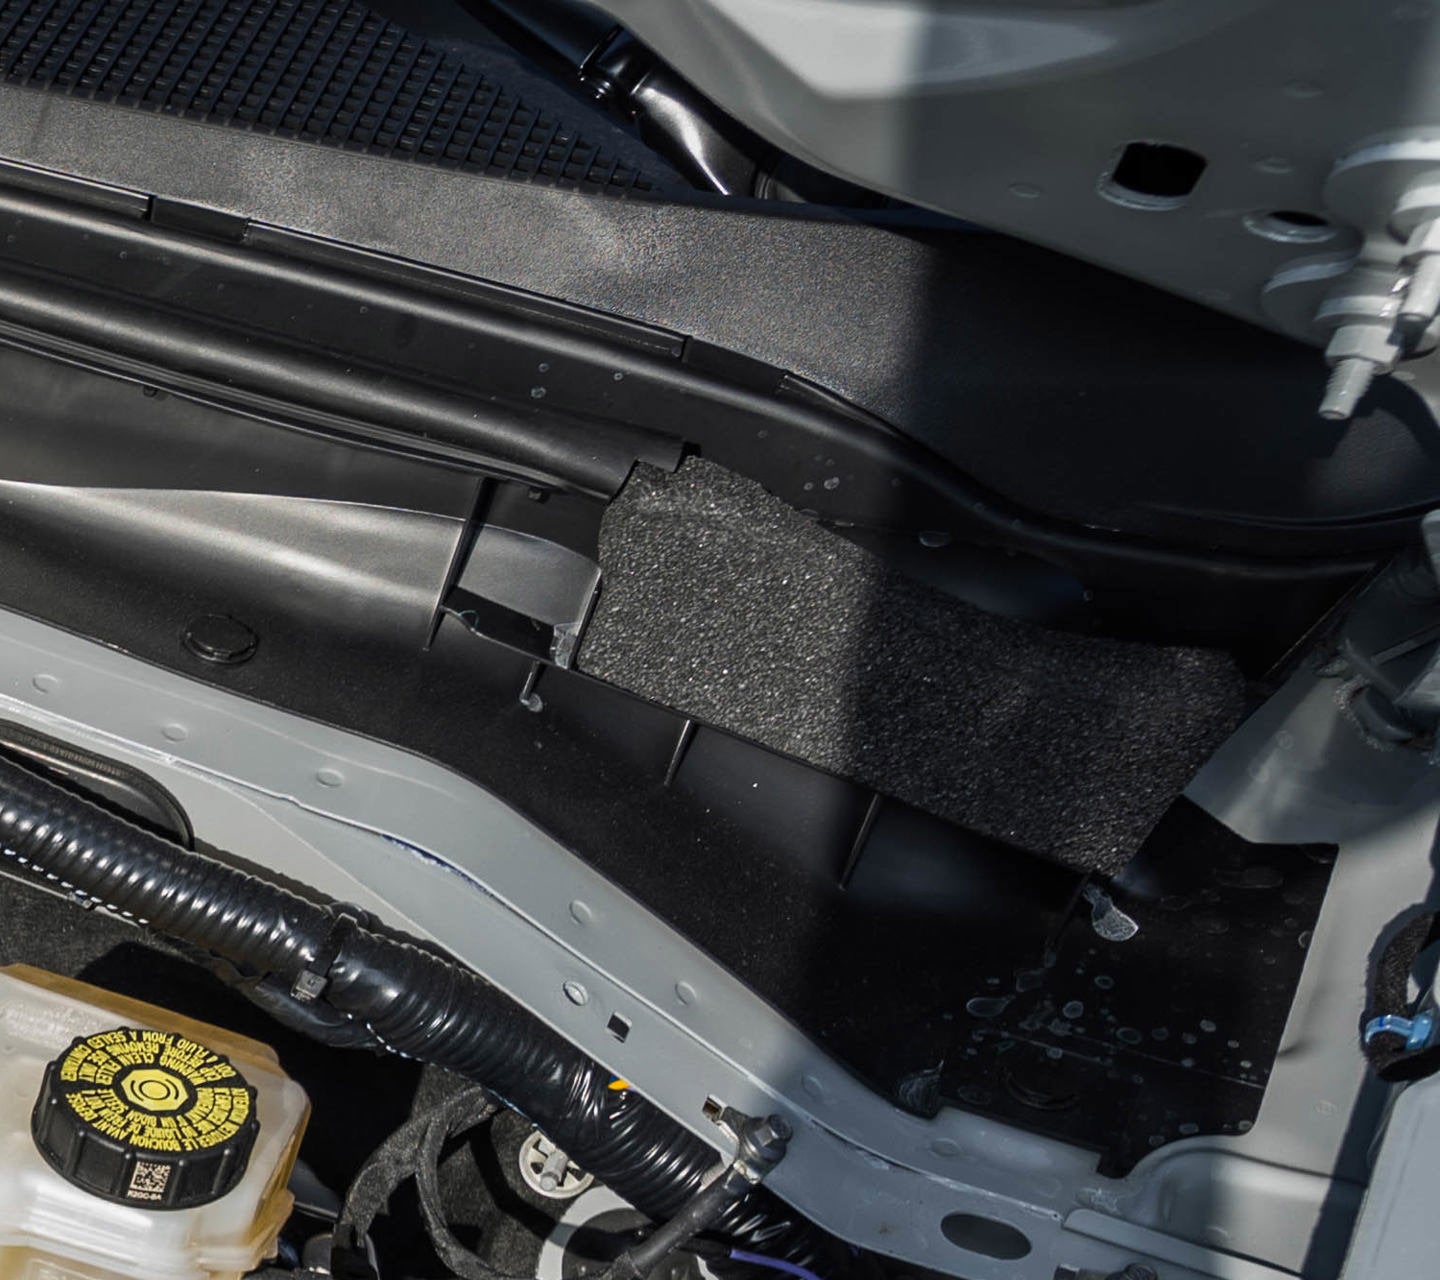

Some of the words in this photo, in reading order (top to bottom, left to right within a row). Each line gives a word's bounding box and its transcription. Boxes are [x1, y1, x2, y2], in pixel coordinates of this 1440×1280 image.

[84, 1030, 127, 1049] SEALED
[128, 1030, 138, 1039] A
[141, 1031, 173, 1046] FROM
[175, 1037, 212, 1057] FLUID
[115, 1052, 153, 1066] CLEAN
[162, 1045, 206, 1067] BEFORE
[158, 1055, 210, 1084] WARNING
[197, 1064, 222, 1081] CAP
[95, 1107, 128, 1127] FREIN
[122, 1110, 156, 1127] BIDON
[88, 1117, 128, 1140] AVANT
[124, 1121, 141, 1134] DE
[142, 1126, 183, 1140] LIQUIDE
[126, 1133, 181, 1150] BOUCHON
[180, 1137, 198, 1150] LE
